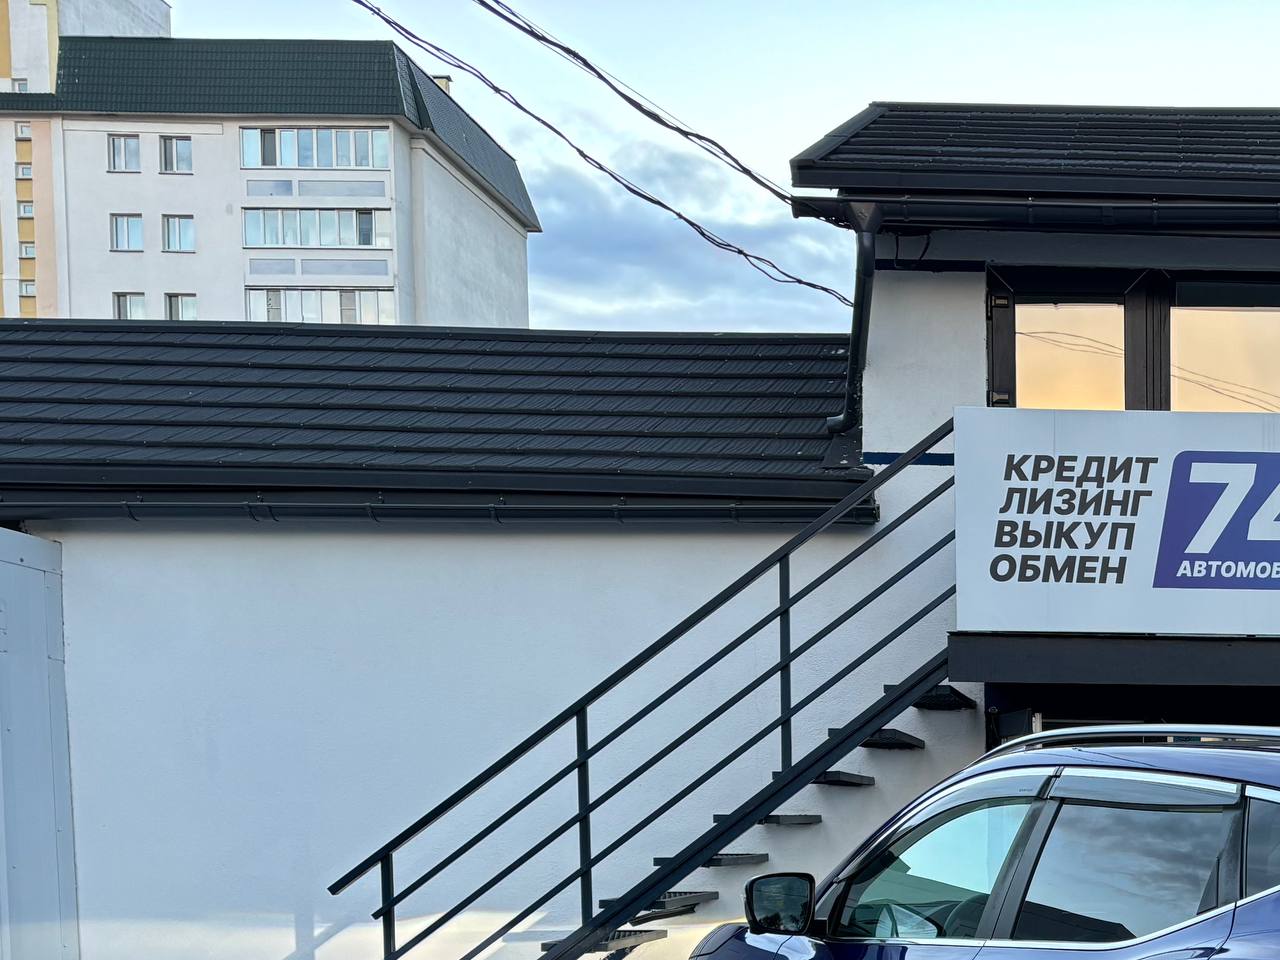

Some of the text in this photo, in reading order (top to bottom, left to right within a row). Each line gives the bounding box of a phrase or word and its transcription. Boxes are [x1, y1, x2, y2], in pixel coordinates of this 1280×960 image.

[1003, 454, 1159, 488] КРЕДИТ
[998, 487, 1153, 517] ЛИЗИНГ
[994, 519, 1136, 551] ВЫКУП
[989, 553, 1128, 584] ОБМЕН
